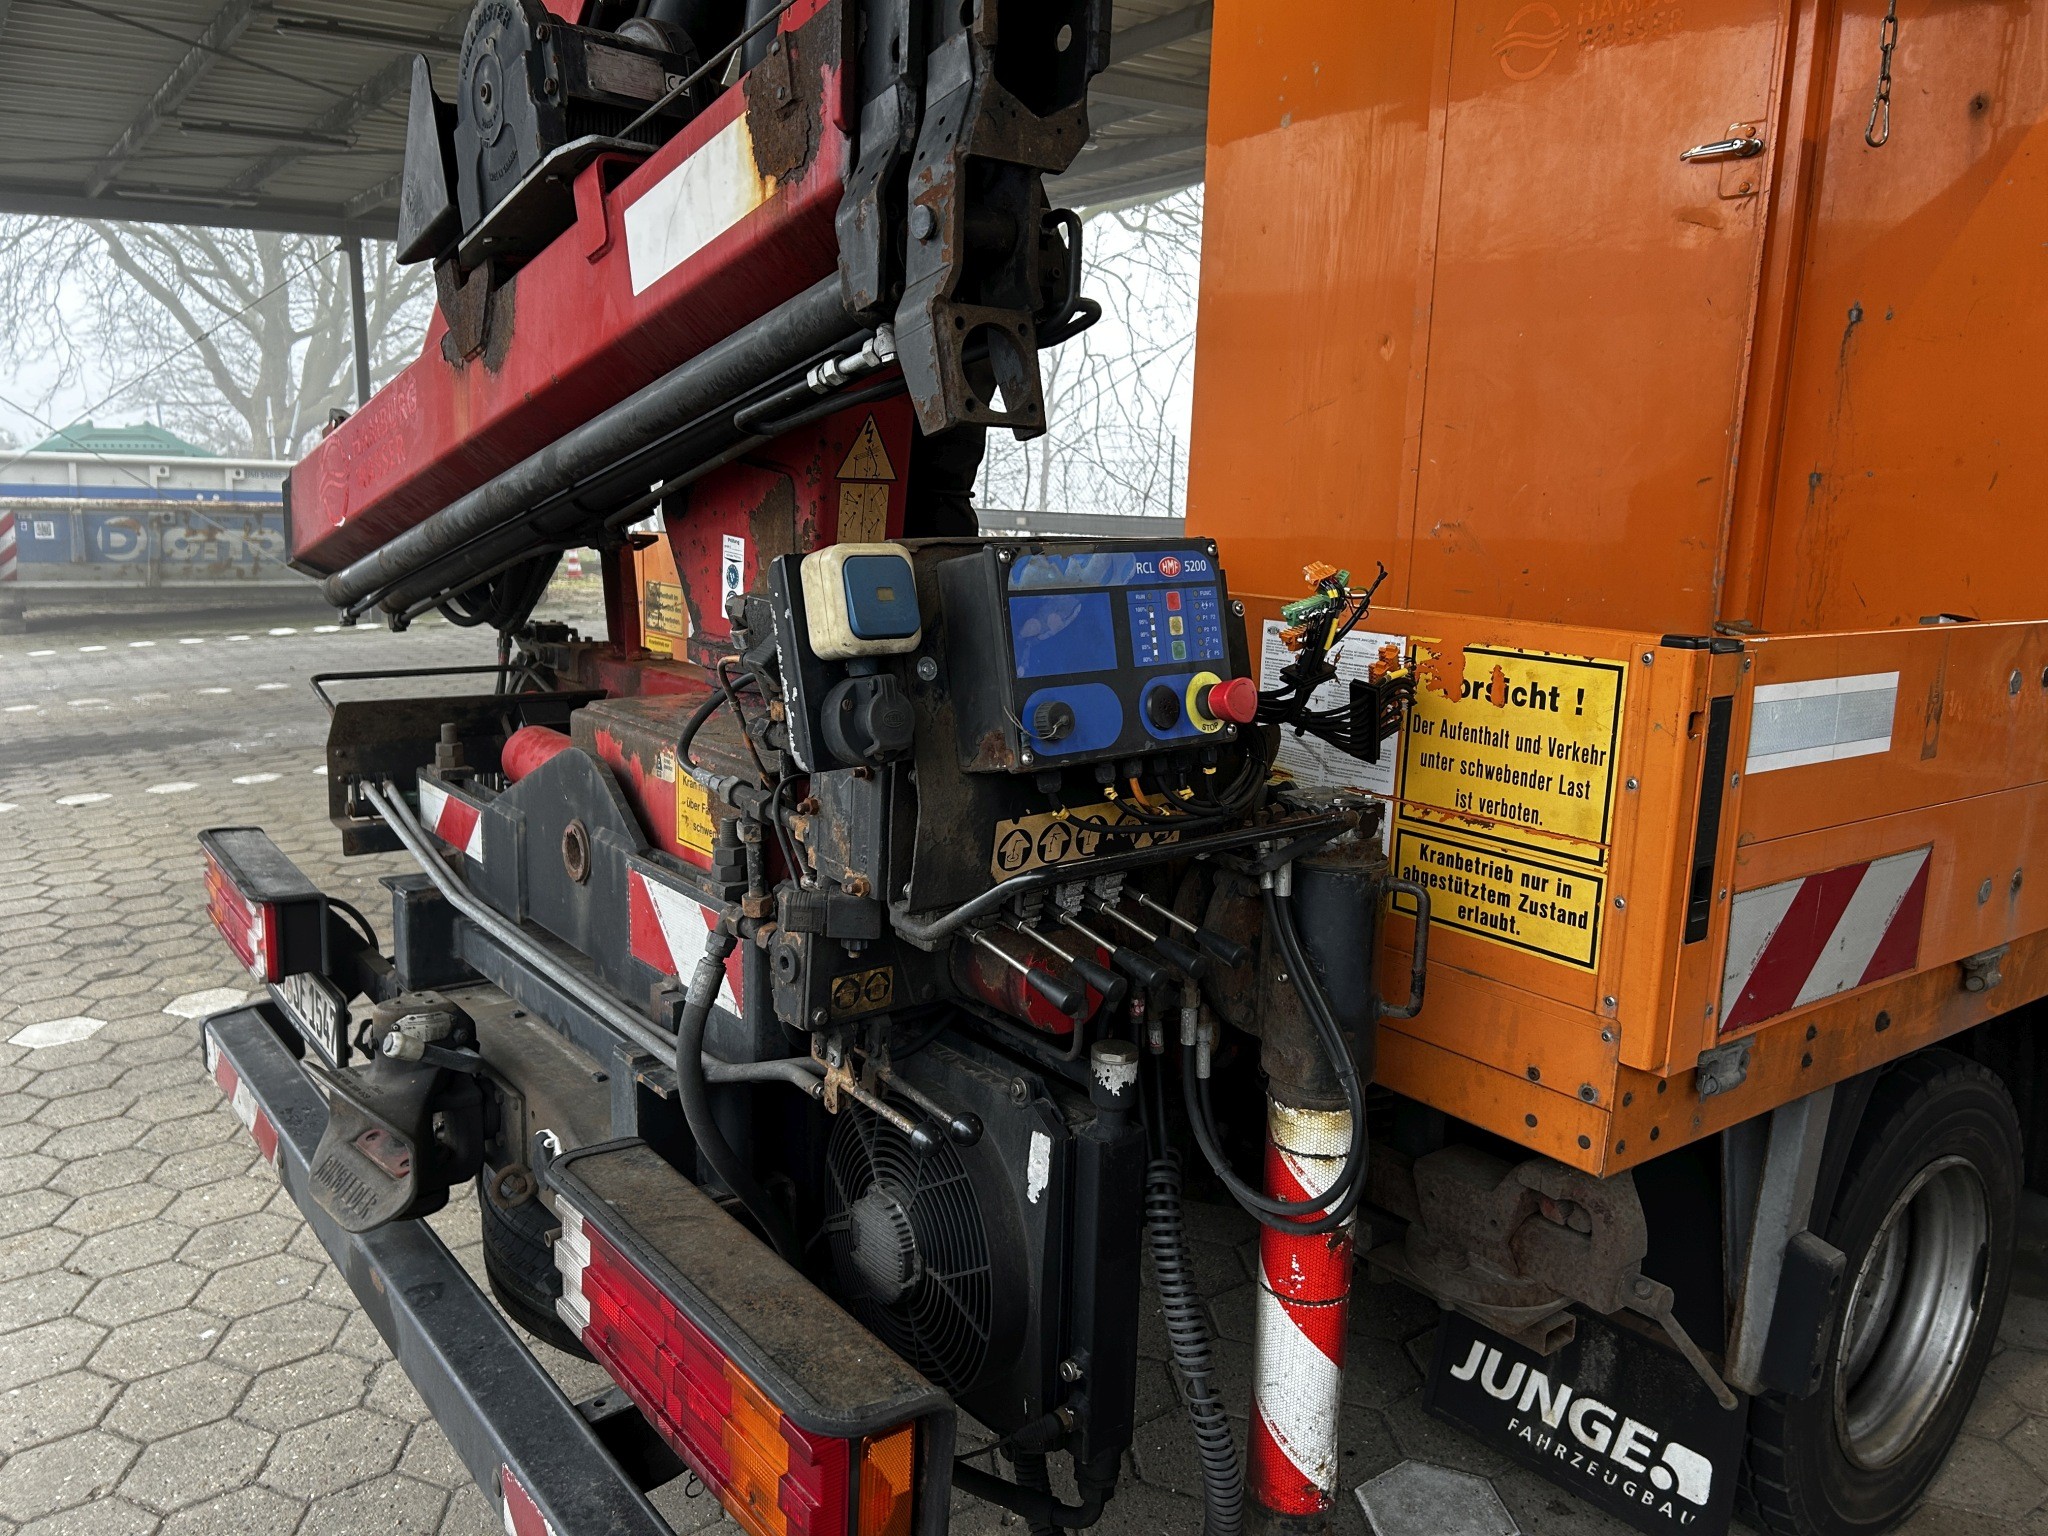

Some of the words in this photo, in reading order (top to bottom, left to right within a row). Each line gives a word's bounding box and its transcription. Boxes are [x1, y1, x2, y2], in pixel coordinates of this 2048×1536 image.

[1136, 562, 1155, 574] RCL
[1162, 559, 1179, 575] HMF
[1184, 560, 1207, 573] 5200
[1575, 688, 1586, 716] !
[1201, 721, 1219, 731] STOP
[1412, 713, 1435, 736] Der
[1439, 719, 1509, 750] Aufenthalt
[1515, 734, 1542, 755] und
[1548, 736, 1607, 767] Verkehr
[682, 775, 697, 788] Kran
[1420, 752, 1455, 773] unter
[1459, 759, 1553, 793] schwebender
[1558, 774, 1591, 800] Last
[686, 797, 700, 812] über
[1454, 789, 1473, 810] ist
[1478, 797, 1543, 827] verboten.
[1419, 842, 1513, 885] Kranbetrieb
[1520, 873, 1549, 894] nur
[1556, 877, 1572, 899] in
[1402, 864, 1511, 910] abgestütztem
[1518, 892, 1589, 930] Zustand
[1457, 904, 1521, 936] erlaubt.
[309, 983, 336, 1056] 1547
[1450, 1339, 1659, 1474] JUNGE
[1507, 1417, 1697, 1526] FAHRZEUGBAU
